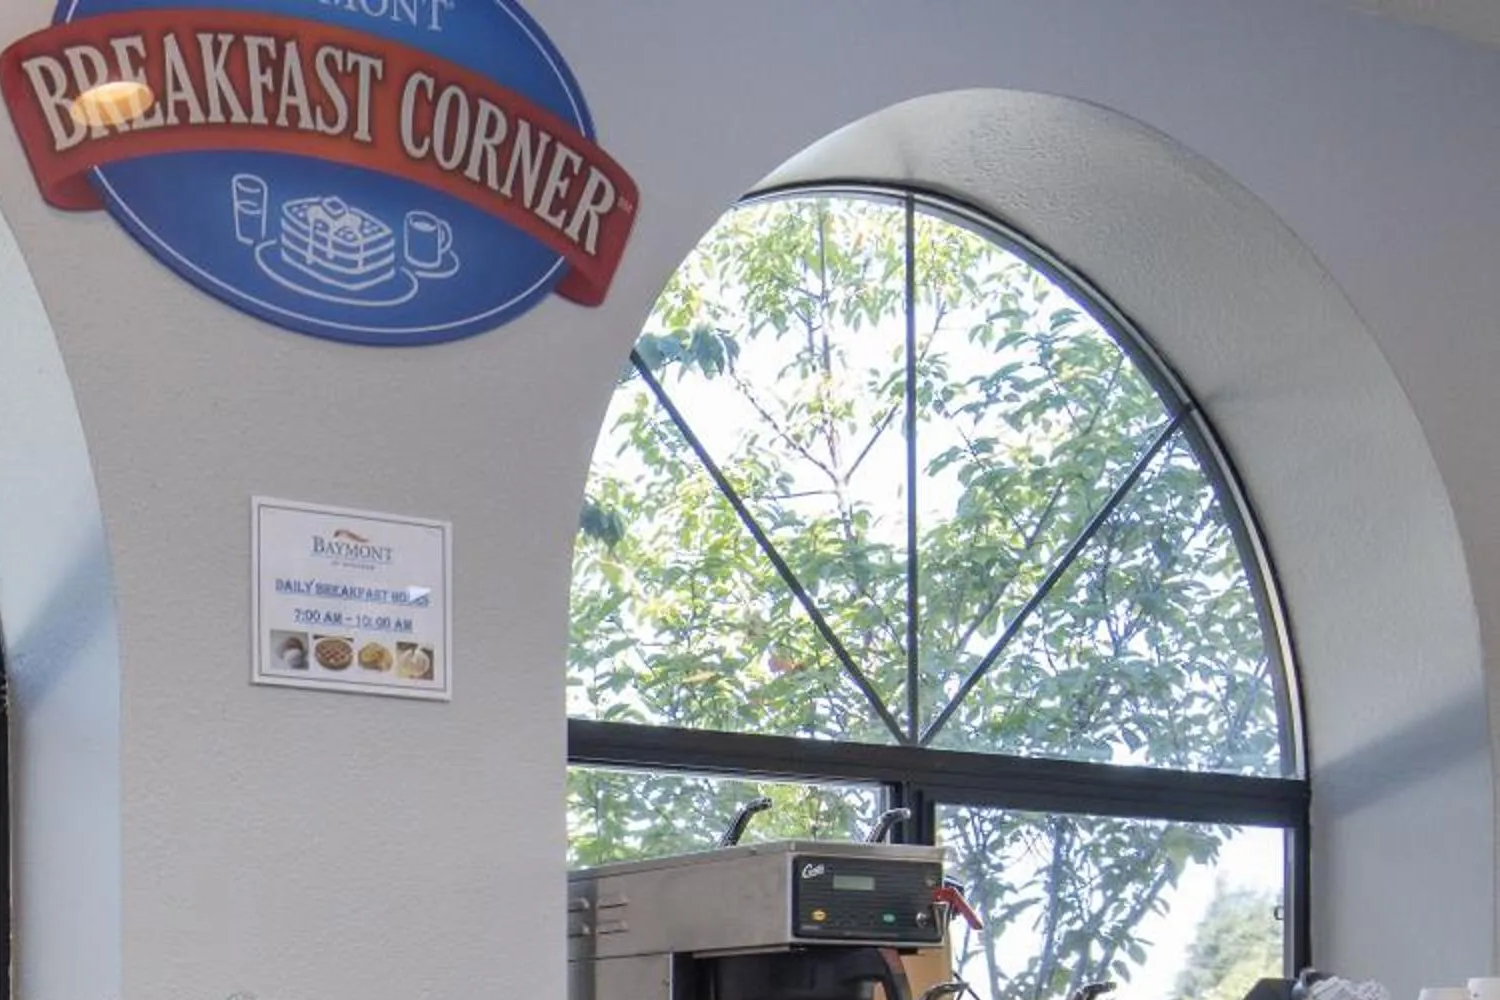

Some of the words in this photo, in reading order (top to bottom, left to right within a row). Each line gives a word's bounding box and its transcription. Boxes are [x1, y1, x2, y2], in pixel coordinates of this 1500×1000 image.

[22, 32, 384, 152] BREAKFAST
[399, 72, 619, 256] CORNER
[275, 578, 315, 594] DAILY
[315, 582, 388, 602] BREAKFAST
[323, 612, 343, 625] AM
[394, 619, 413, 633] AM
